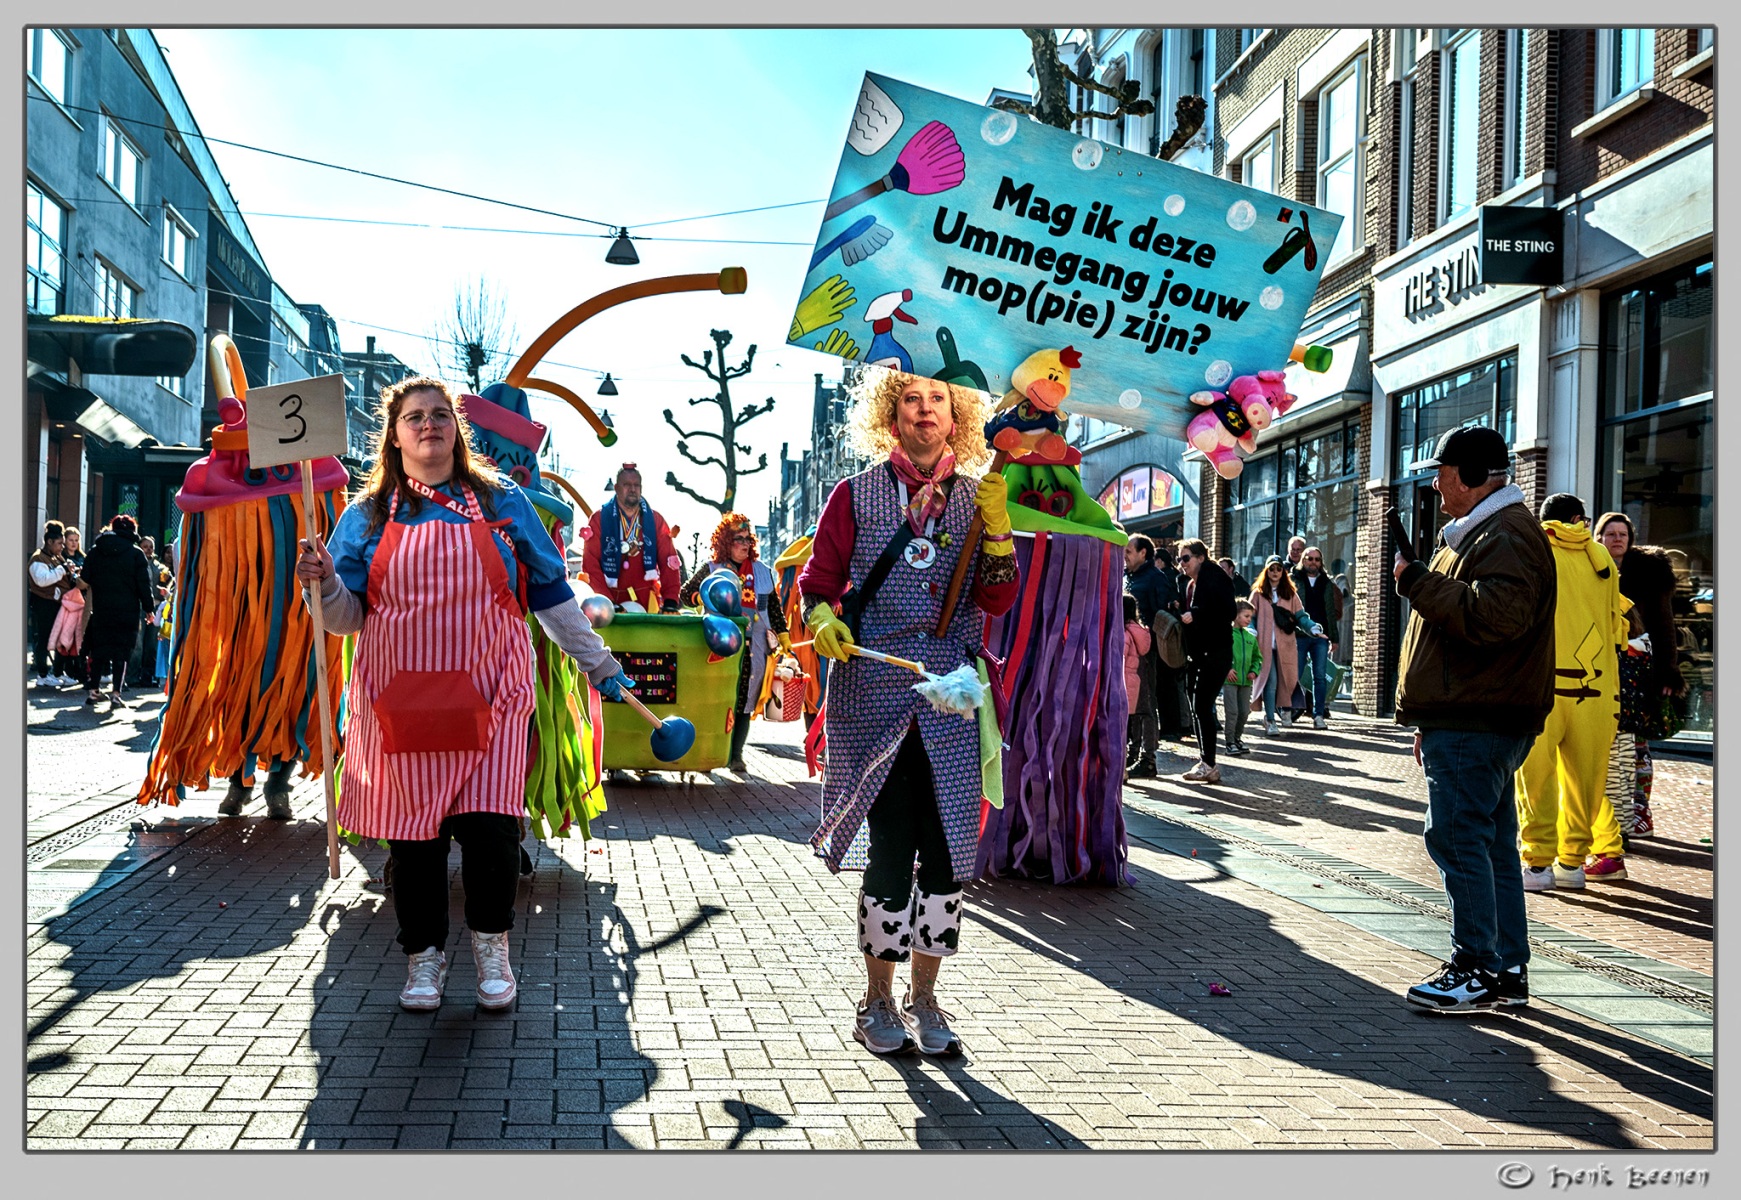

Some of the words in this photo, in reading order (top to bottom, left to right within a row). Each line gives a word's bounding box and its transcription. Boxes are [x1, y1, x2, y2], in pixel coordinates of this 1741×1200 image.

[992, 176, 1078, 237] Mag
[1082, 201, 1124, 243] ik
[1128, 216, 1217, 269] deze
[1486, 239, 1511, 252] THE
[1514, 240, 1555, 253] STING
[932, 205, 1150, 303] Ummegang
[1148, 268, 1251, 322] jouw
[1401, 266, 1435, 317] THE
[1437, 245, 1480, 300] STIN
[941, 265, 1115, 340] mop(pie)
[1119, 309, 1212, 355] zijn?
[278, 394, 307, 444] 3
[407, 478, 435, 499] ALDI
[445, 500, 473, 518] ALD
[630, 658, 664, 666] HELPEN
[625, 674, 672, 682] SENBURG
[646, 688, 668, 696] ZEEP
